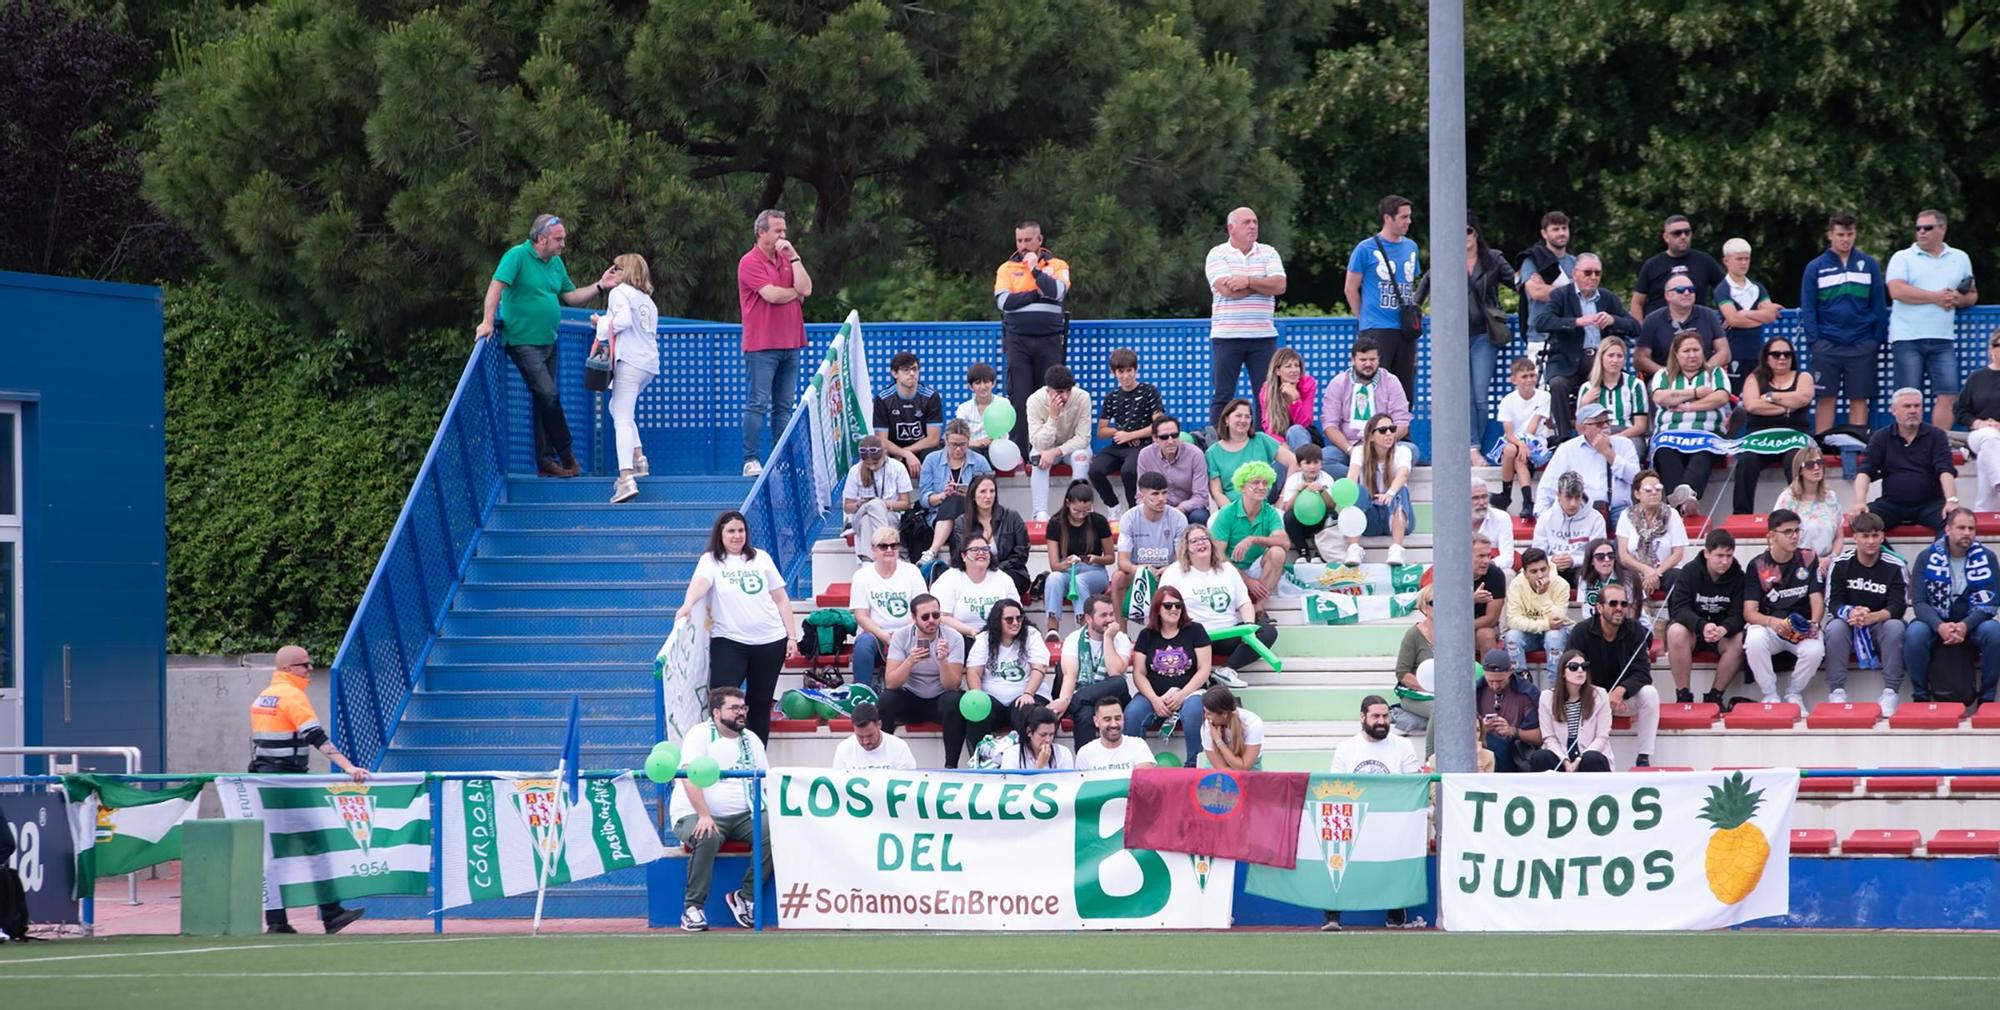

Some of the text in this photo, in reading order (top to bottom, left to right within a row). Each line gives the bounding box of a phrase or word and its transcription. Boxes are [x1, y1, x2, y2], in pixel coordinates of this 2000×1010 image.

[1750, 435, 1806, 448] CÓRDOBA
[780, 774, 1059, 820] LOS FIELES
[1464, 787, 1663, 839] TODOS
[468, 779, 491, 888] CÓRDOBA
[877, 832, 963, 873] DEL
[1075, 778, 1172, 918] B
[350, 861, 390, 877] 1954
[1458, 849, 1675, 899] JUNTOS
[779, 882, 1060, 918] #SoñamosEnBronce
